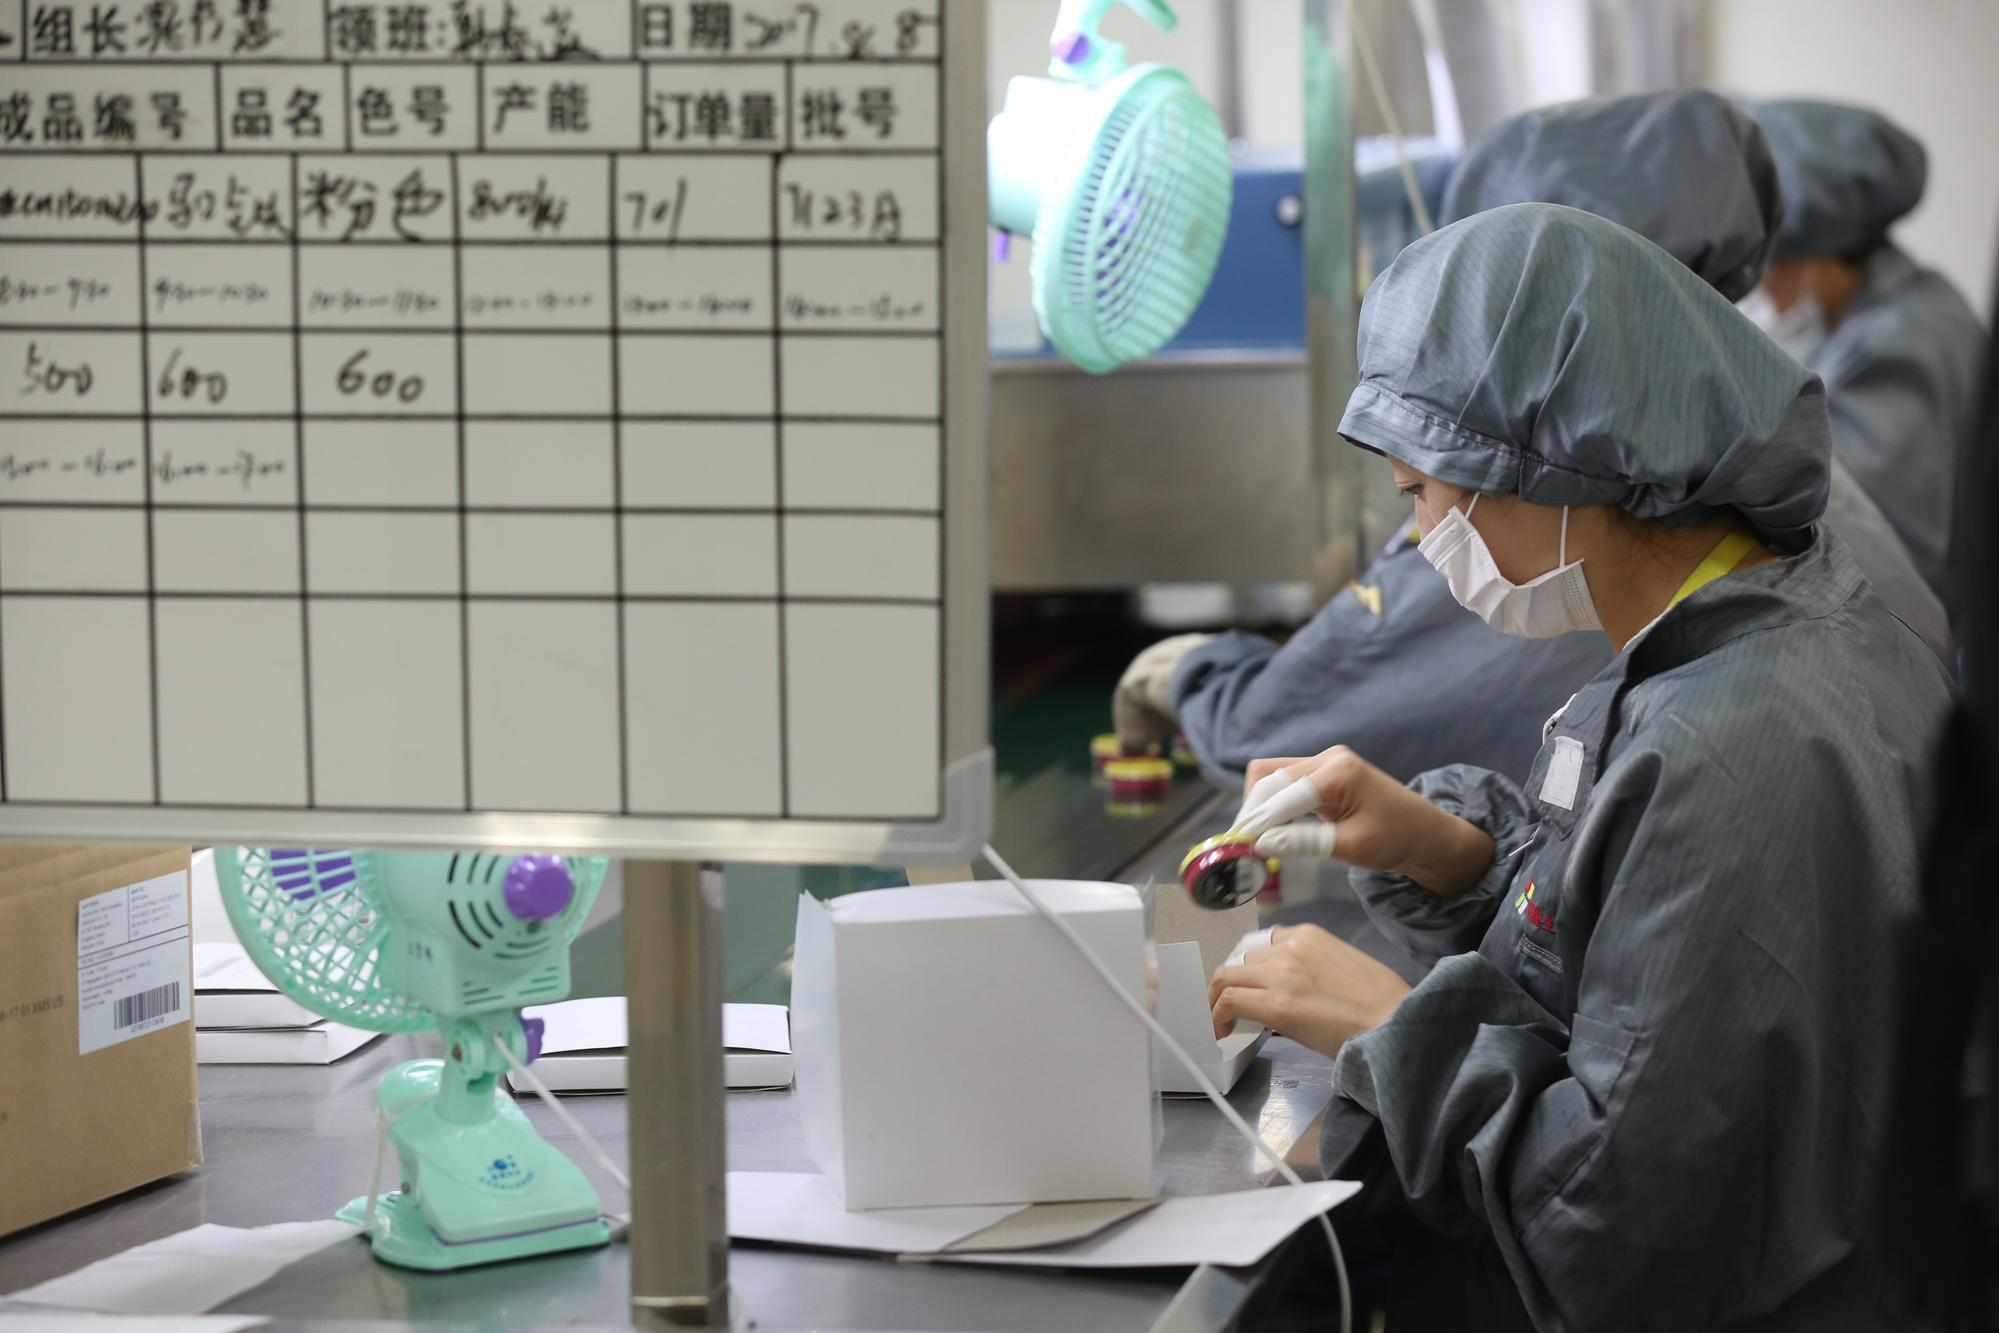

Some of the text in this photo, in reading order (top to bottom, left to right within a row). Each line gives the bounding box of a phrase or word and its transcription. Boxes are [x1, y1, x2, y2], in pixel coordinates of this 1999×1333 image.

[230, 87, 325, 139] 品名
[356, 84, 450, 138] 色号
[492, 82, 591, 135] 产能
[648, 90, 778, 143] 订单量
[800, 86, 897, 139] 批号
[19, 342, 95, 397] 500
[157, 346, 228, 404] 600
[336, 347, 426, 404] 600
